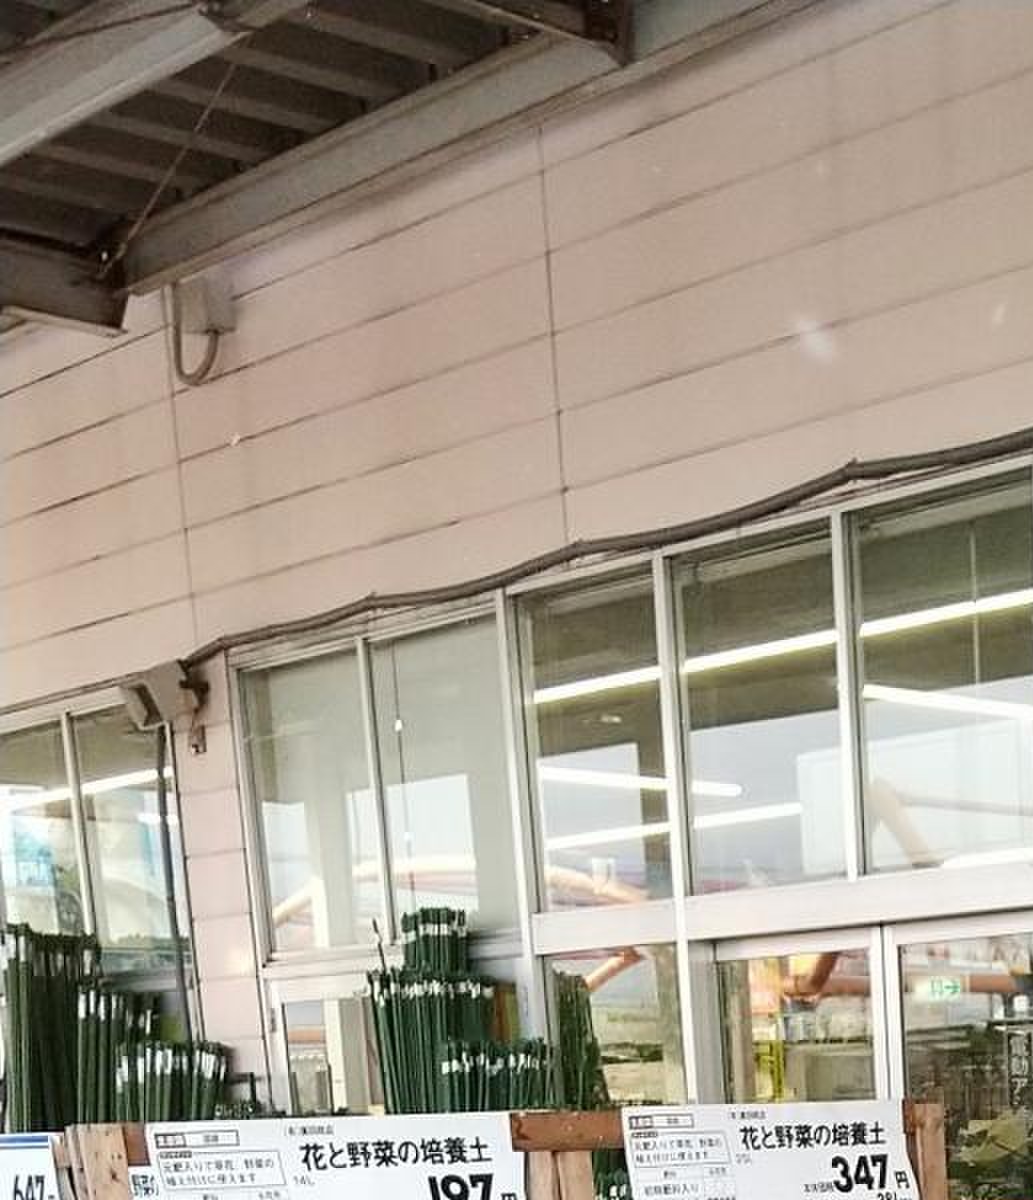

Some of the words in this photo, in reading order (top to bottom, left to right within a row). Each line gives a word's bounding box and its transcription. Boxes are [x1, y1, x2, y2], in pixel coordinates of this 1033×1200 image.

[740, 1122, 886, 1151] 花と野菜の培養土
[300, 1137, 493, 1171] 花と野菜の培養土
[831, 1154, 888, 1193] 347
[895, 1170, 911, 1189] 円
